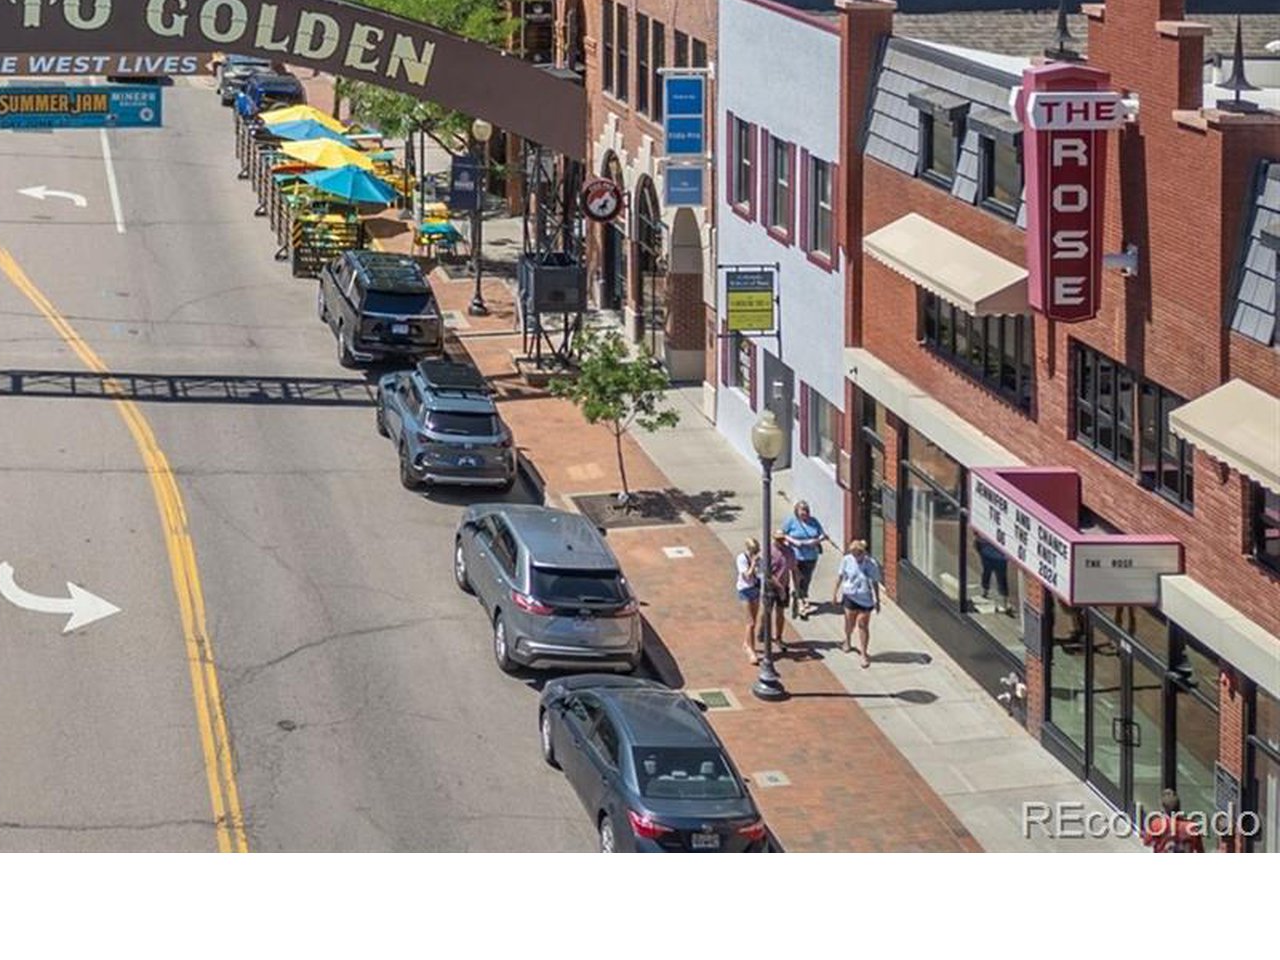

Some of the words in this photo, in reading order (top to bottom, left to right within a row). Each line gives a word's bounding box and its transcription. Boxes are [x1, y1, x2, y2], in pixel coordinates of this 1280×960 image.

[28, 56, 110, 74] WEST
[117, 55, 197, 74] LIVES
[71, 93, 108, 114] JAM
[1038, 101, 1117, 124] THE
[1052, 138, 1089, 306] ROSE
[989, 506, 1001, 526] TIE
[1014, 523, 1028, 547] THE
[1036, 542, 1057, 567] KNOT
[1015, 508, 1031, 531] AND
[1037, 525, 1069, 560] CHANCE
[1038, 560, 1058, 587] 2024
